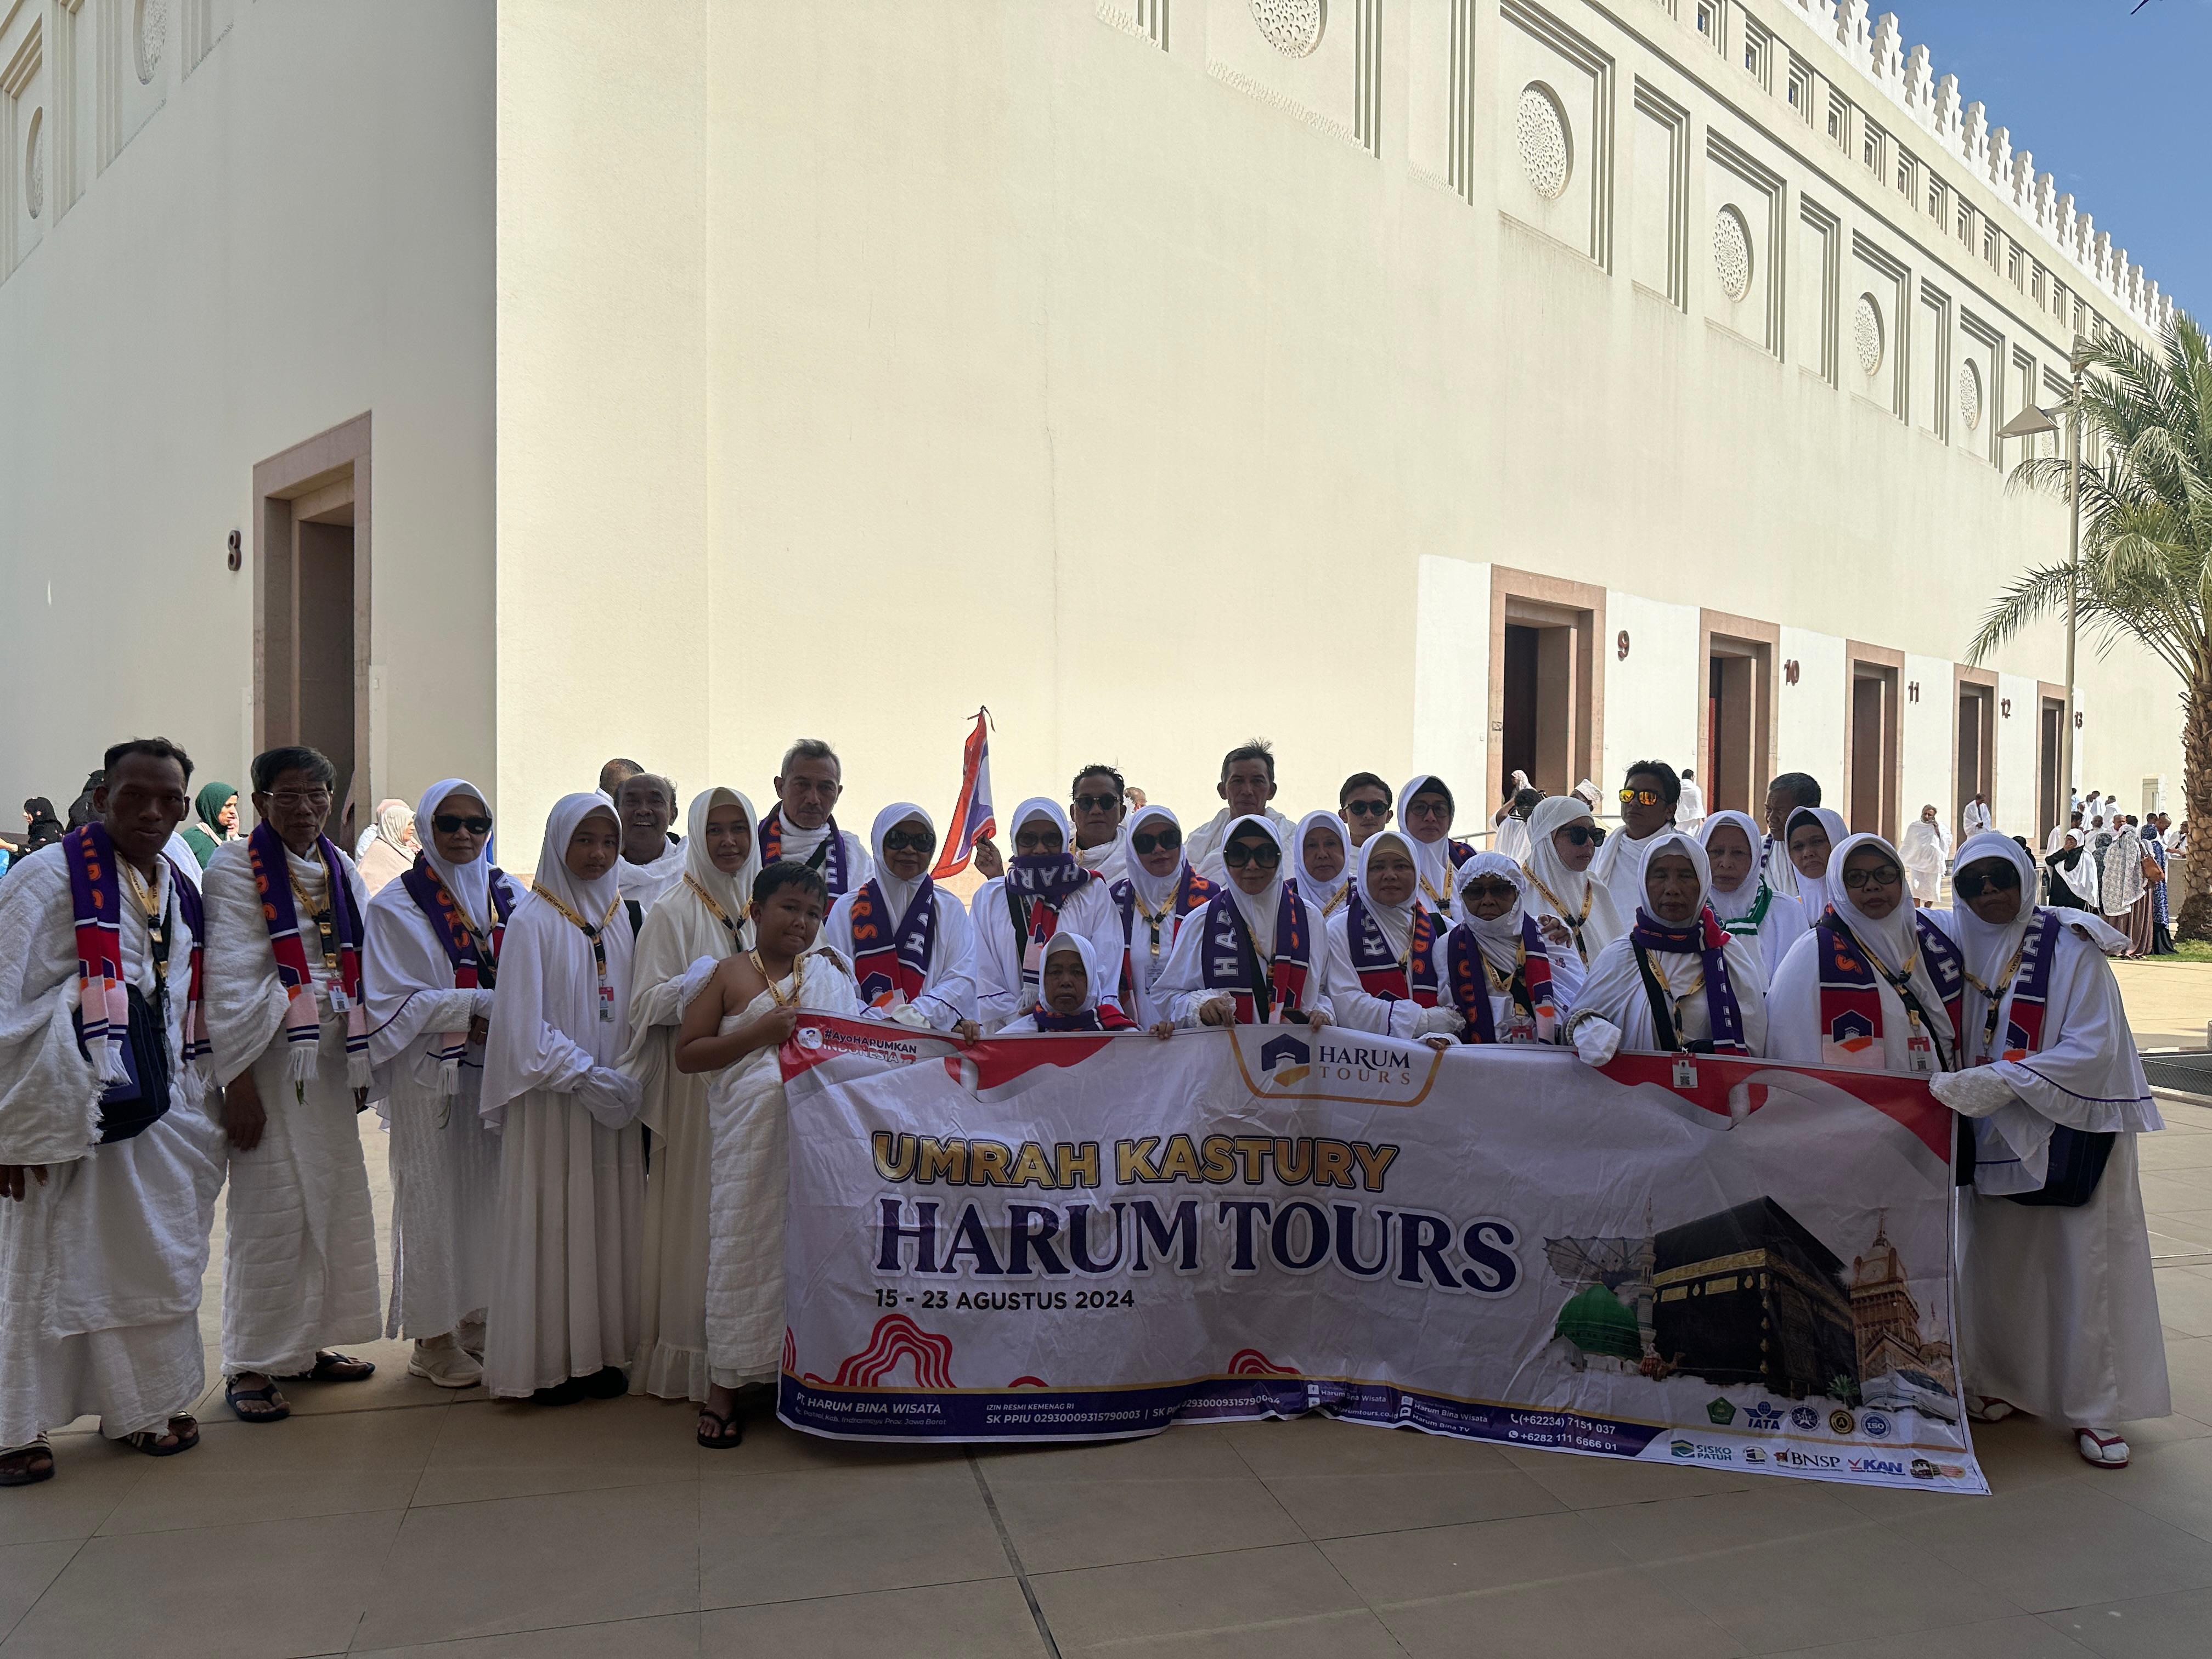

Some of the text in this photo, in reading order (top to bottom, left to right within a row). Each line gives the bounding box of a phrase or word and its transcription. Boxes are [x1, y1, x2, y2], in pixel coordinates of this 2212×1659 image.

[228, 530, 241, 571] 8
[1617, 630, 1629, 662] 9
[1784, 659, 1799, 686] 10
[1908, 681, 1919, 705] 11
[2001, 698, 2011, 719] 12
[2074, 711, 2083, 730] 13
[2008, 952, 2022, 974] WISATA
[824, 1029, 917, 1054] #AyoHARUMKAN
[823, 1042, 899, 1064] INDONESIA
[1319, 1045, 1410, 1070] HARUM
[1318, 1065, 1410, 1085] TOURS
[871, 1131, 1400, 1193] UMRAH KASTURY
[874, 1197, 1519, 1294] HARUM TOURS
[875, 1288, 898, 1308] 15
[926, 1290, 949, 1310] 23
[956, 1291, 1067, 1311] AGUSTUS
[1075, 1289, 1135, 1309] 2024
[797, 1391, 942, 1414] PT. HARUM BINA WISATA
[1362, 1395, 1386, 1403] Wisata
[986, 1414, 1001, 1424] SK
[1003, 1414, 1031, 1424] PPIU
[1034, 1409, 1141, 1423] 02930009315790003
[1152, 1408, 1166, 1418] SK
[1413, 1413, 1438, 1427] Harum
[1414, 1403, 1440, 1415] Harum
[1441, 1409, 1459, 1419] Bina
[1460, 1413, 1488, 1423] Wisata
[1519, 1414, 1616, 1435] (+62234) 7151 037
[1748, 1418, 1780, 1430] IATA
[1866, 1421, 1886, 1430] ISO
[1521, 1432, 1617, 1451] +6282 111 6666 01
[1696, 1444, 1732, 1454] SISKO
[1697, 1453, 1732, 1461] PATUH
[1791, 1451, 1840, 1468] BNSP
[1863, 1459, 1902, 1473] KAN
